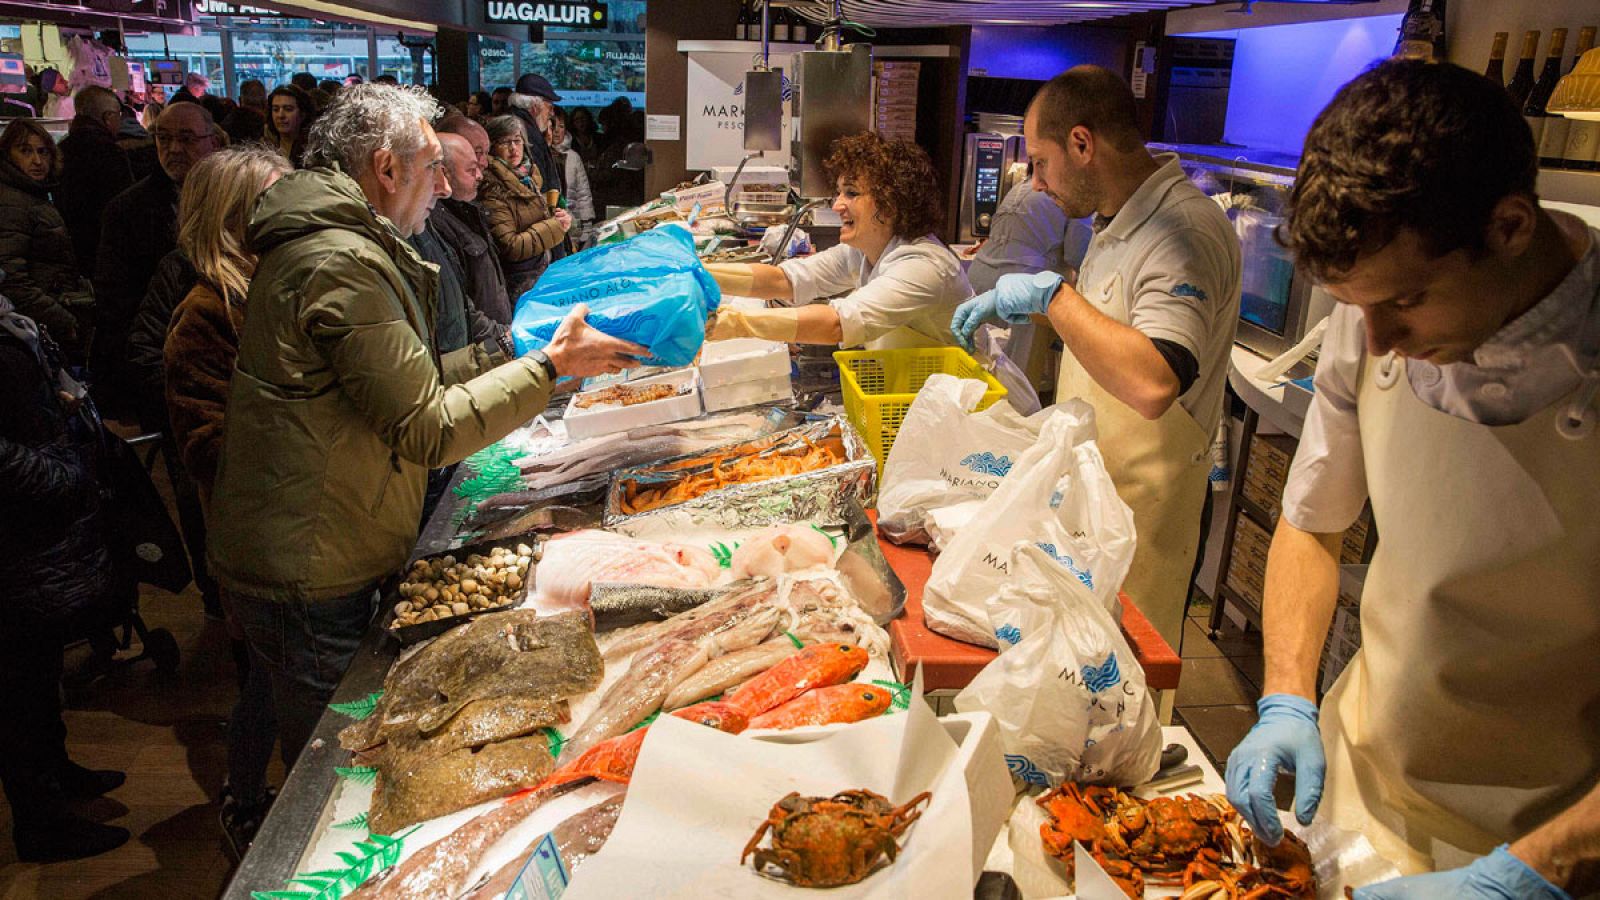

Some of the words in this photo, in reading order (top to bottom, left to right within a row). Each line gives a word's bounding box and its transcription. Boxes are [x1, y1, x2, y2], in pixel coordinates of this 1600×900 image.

[487, 0, 590, 24] UAGALUR
[551, 287, 600, 308] ARIANO
[939, 468, 1000, 489] MARIANO
[982, 552, 1009, 575] MA
